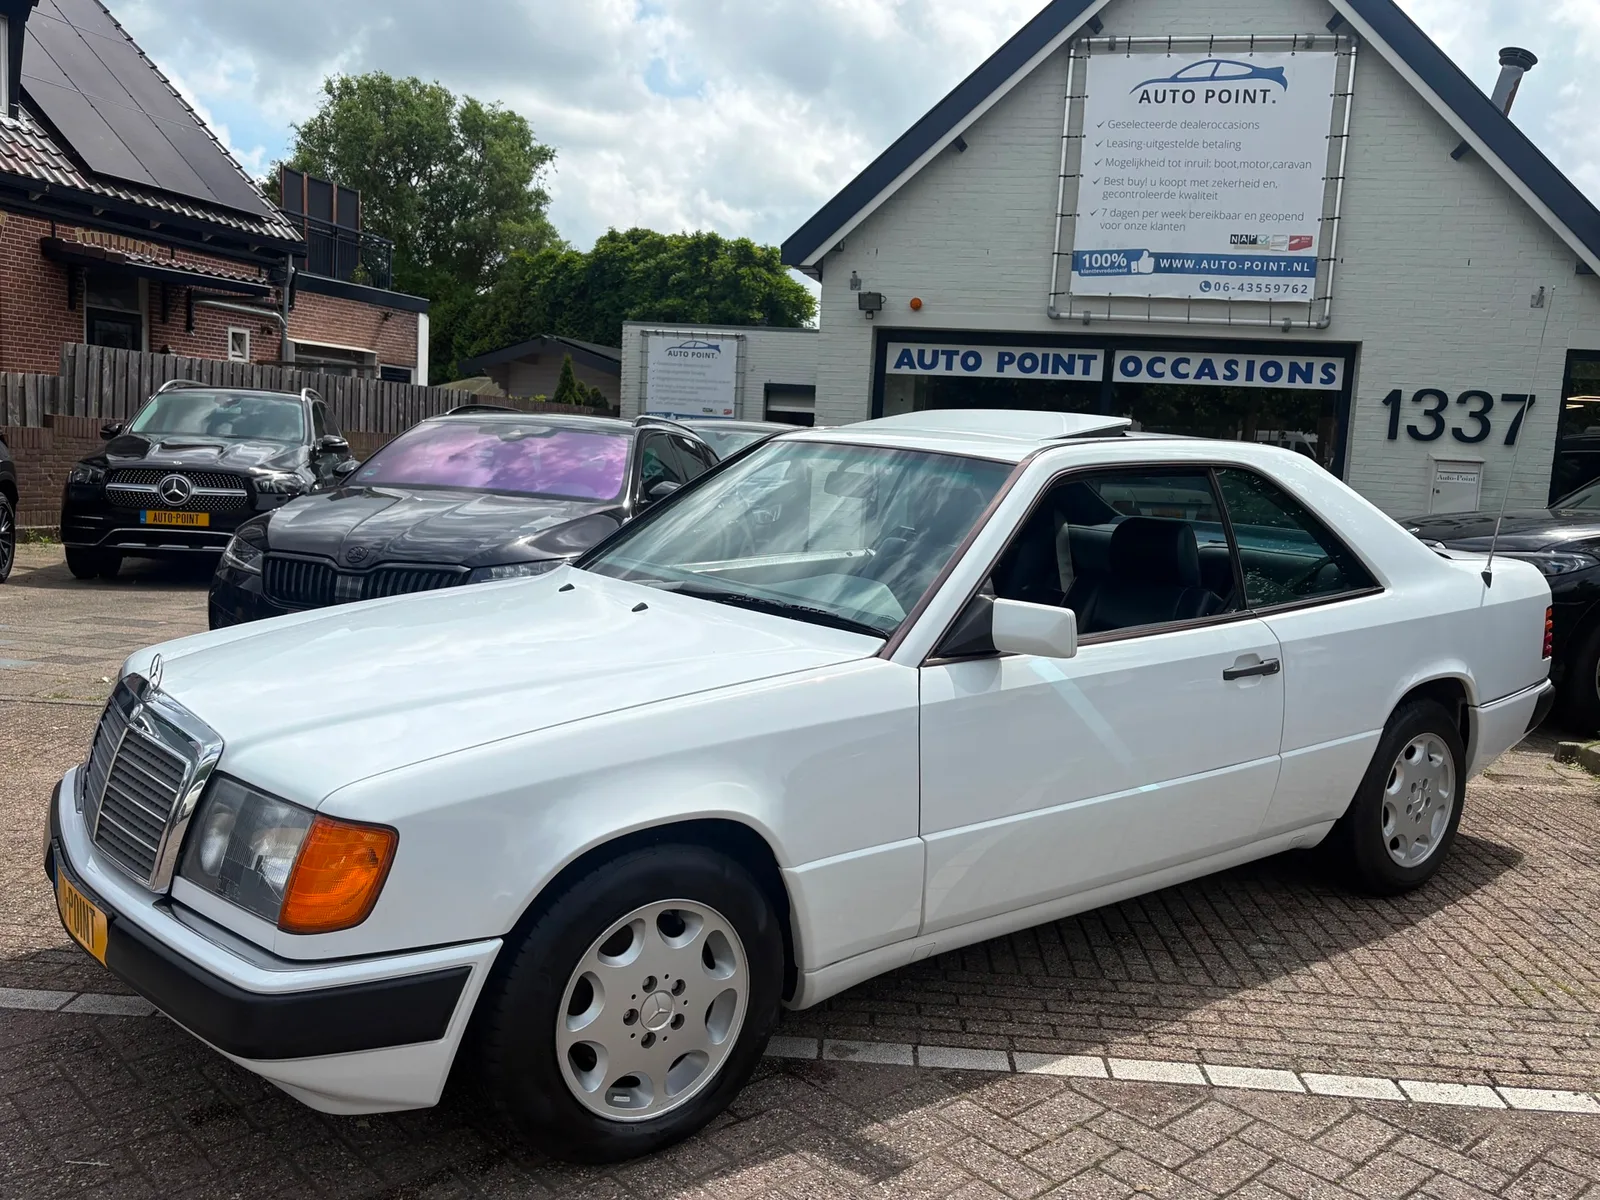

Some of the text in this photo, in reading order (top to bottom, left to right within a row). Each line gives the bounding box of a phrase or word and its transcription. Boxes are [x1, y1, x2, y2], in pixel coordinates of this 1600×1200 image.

[1139, 89, 1276, 104] AUTO POINT.
[1107, 119, 1260, 130] Geselecteerde dealeroccasions
[1106, 139, 1242, 152] Leasing-uitgestelde betaling
[1105, 157, 1165, 169] Mogelijkheid
[1168, 160, 1181, 168] tot
[1184, 159, 1212, 168] inruil:
[1103, 176, 1278, 189] Best buy! u koopt met zekerheid en,
[1102, 190, 1218, 200] gecontroleerde kwaliteit
[1101, 208, 1304, 223] 7 dagen per week bereikbaar en geopend
[1100, 221, 1186, 231] voor onze klanten
[1230, 234, 1257, 244] NAP
[1082, 253, 1127, 267] 100%
[1159, 258, 1310, 272] WWW.AUTO-POINT.NL
[1213, 281, 1308, 294] 06-43559762
[667, 350, 689, 358] AUTO
[894, 347, 1098, 377] AUTO POINT
[1119, 355, 1337, 385] OCCASIONS
[1382, 388, 1536, 446] 1337
[1436, 474, 1476, 482] Auto-Point
[153, 512, 200, 524] AUTO-POINT
